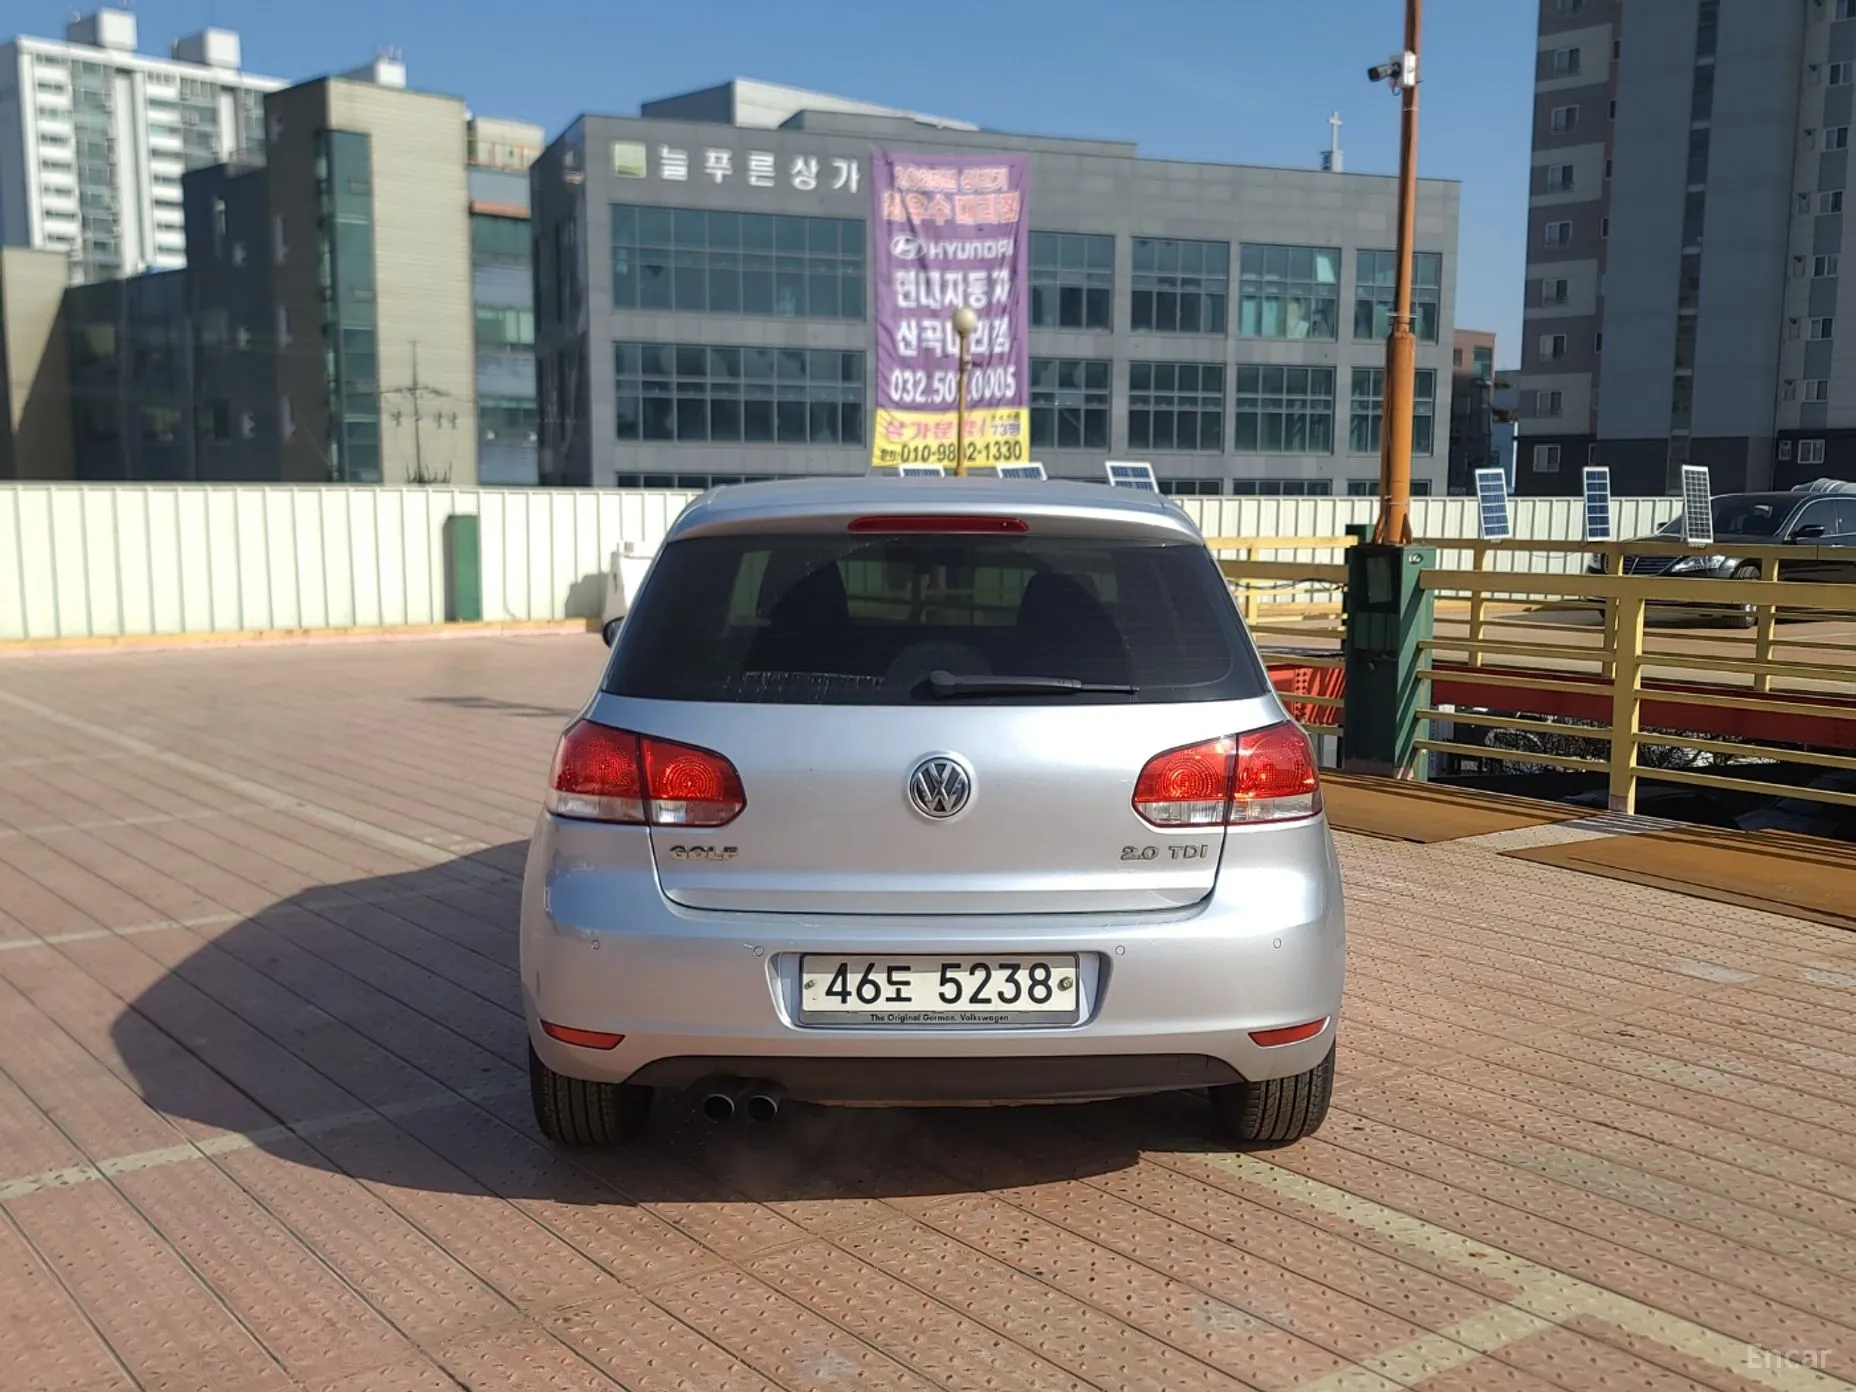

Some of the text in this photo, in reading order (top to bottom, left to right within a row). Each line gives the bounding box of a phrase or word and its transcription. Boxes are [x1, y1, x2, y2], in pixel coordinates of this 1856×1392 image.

[890, 366, 1017, 404] 032.50.0005
[900, 440, 1023, 464] 010-982-1330
[670, 845, 737, 861] GOLF
[1120, 844, 1209, 861] 2.0 TDI
[825, 962, 1053, 1005] 46도 5238
[887, 1014, 920, 1023] Original
[960, 1014, 1009, 1024] Volkswagen
